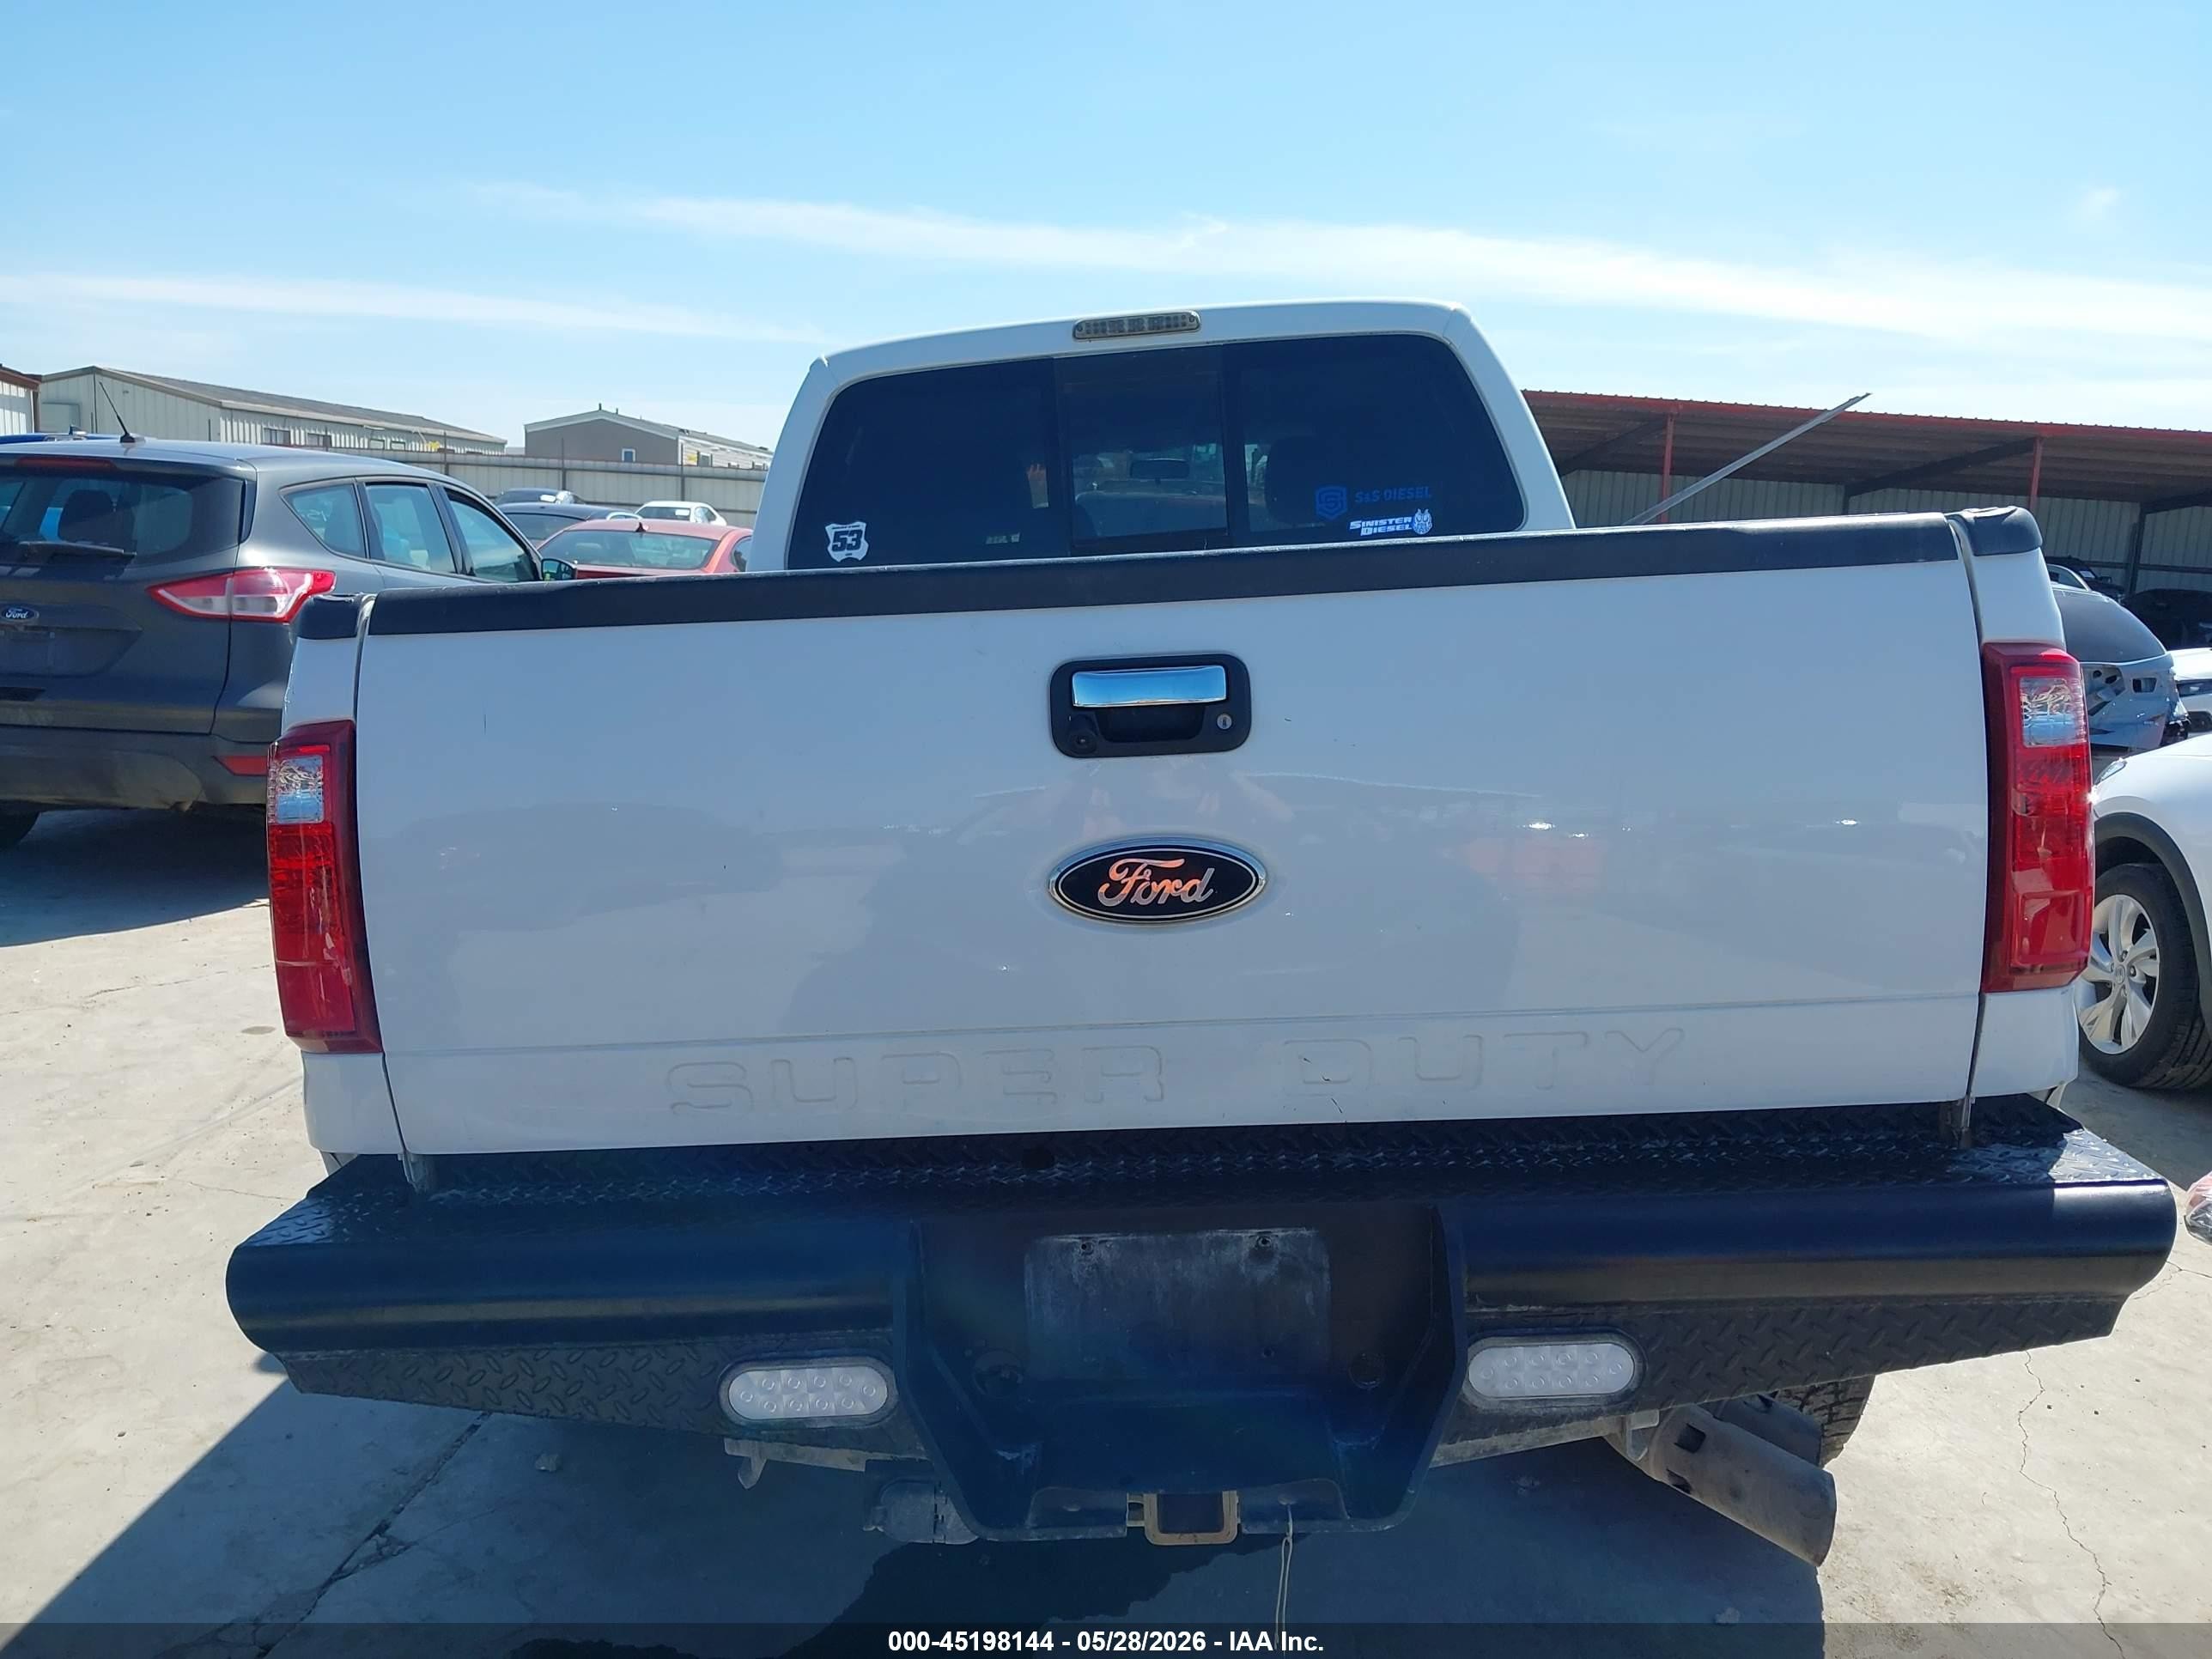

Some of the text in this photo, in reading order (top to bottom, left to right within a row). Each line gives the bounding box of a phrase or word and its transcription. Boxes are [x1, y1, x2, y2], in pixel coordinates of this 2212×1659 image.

[1383, 487, 1431, 501] DIESEL
[1349, 516, 1413, 530] SINISTER
[1360, 524, 1413, 537] DIESEL
[832, 529, 863, 552] 53
[1097, 858, 1215, 907] Ford
[665, 1028, 1685, 1114] SUPER DUTY
